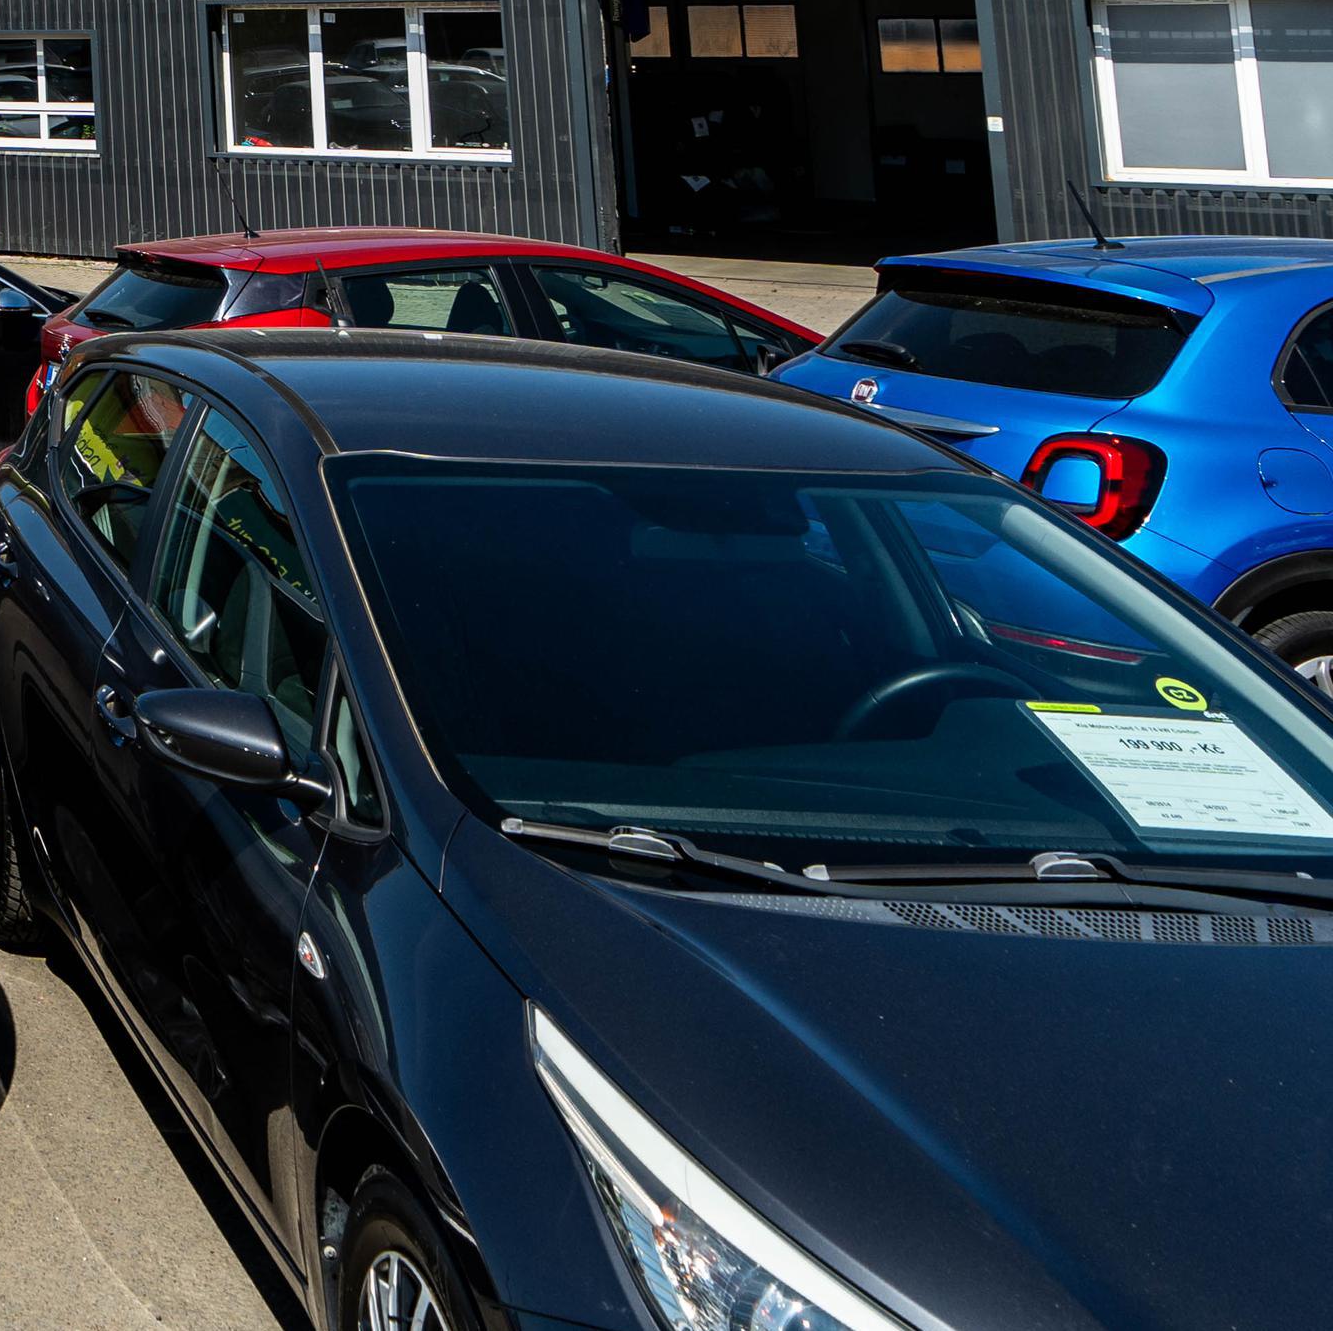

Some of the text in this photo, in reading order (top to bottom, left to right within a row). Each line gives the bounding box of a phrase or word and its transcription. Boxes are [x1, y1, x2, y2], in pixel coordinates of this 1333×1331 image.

[1119, 738, 1150, 750] 199
[1150, 740, 1183, 752] 900
[1198, 742, 1225, 755] Kč
